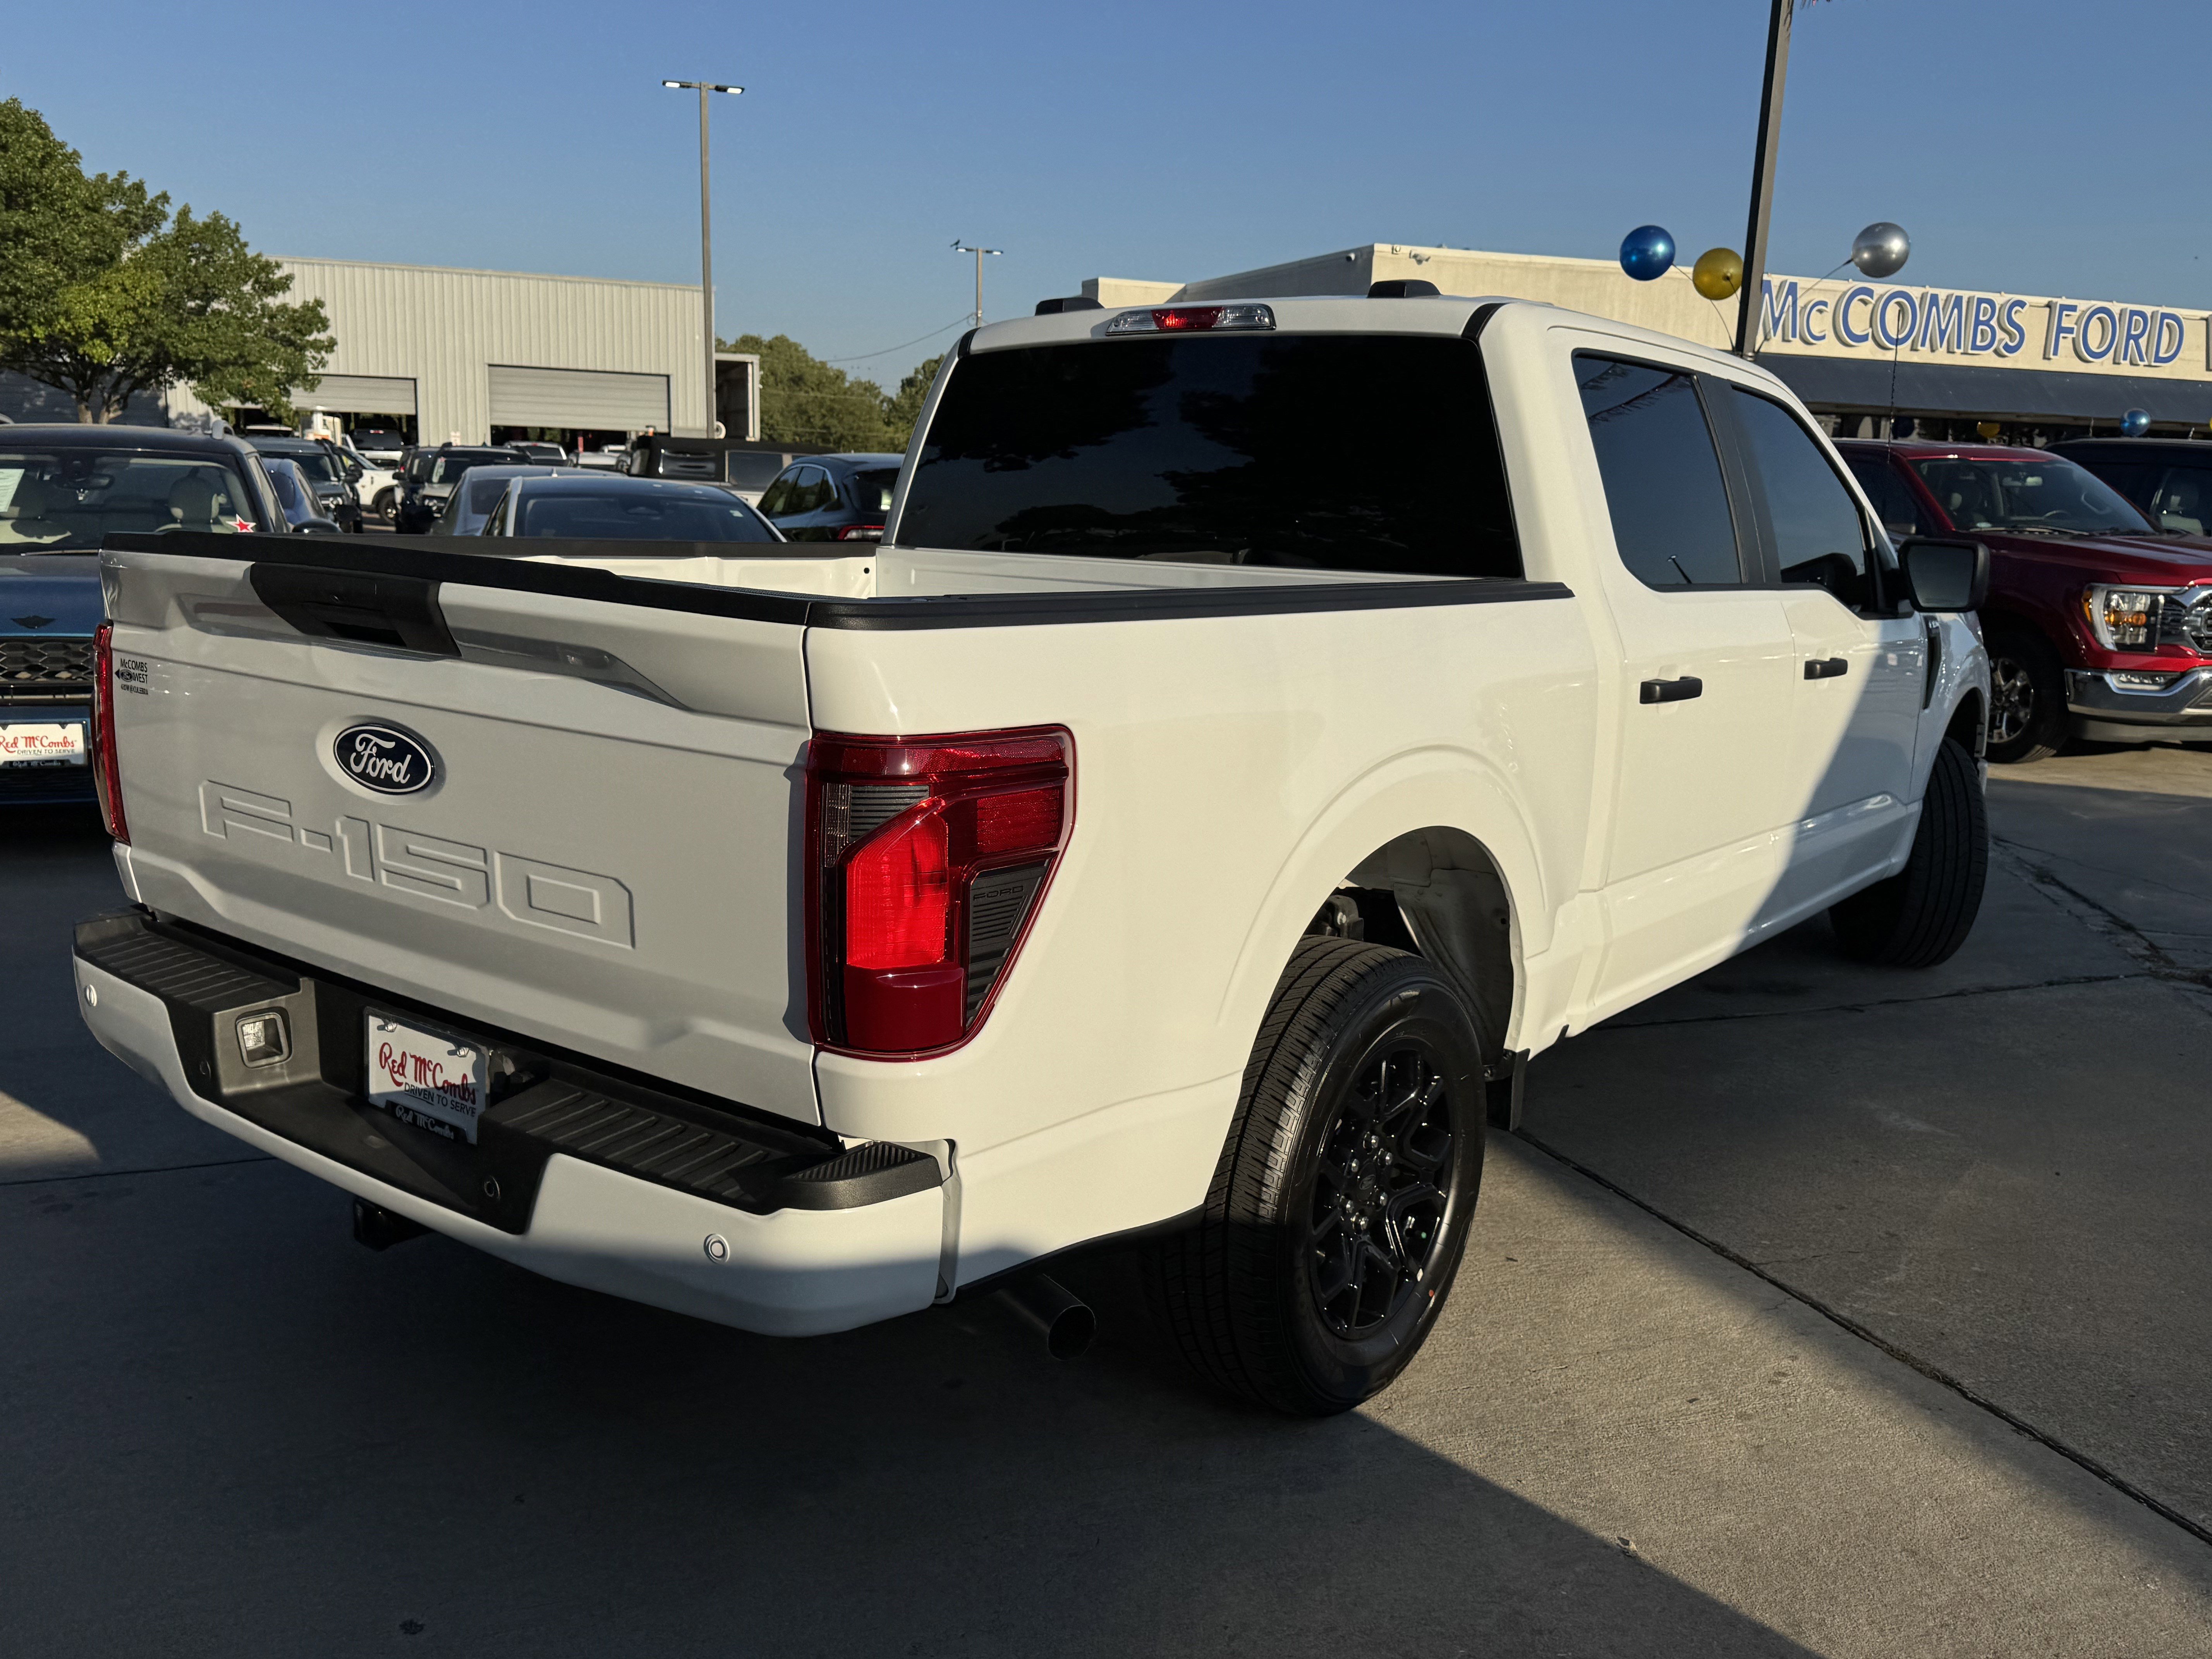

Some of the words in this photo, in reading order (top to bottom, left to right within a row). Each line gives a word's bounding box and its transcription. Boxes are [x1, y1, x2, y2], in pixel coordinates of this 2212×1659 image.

[1757, 277, 2029, 357] McCOMBS
[2045, 301, 2185, 367] FORD
[132, 672, 148, 684] WEST
[21, 735, 74, 749] McCombs
[350, 733, 411, 783] Ford
[199, 780, 635, 949] F-150
[973, 886, 1024, 901] FORD
[379, 1042, 406, 1087] Red
[409, 1052, 476, 1104] McCombs
[395, 1104, 413, 1123] Red
[404, 1082, 434, 1103] DRIVEN
[436, 1094, 448, 1107] TO
[450, 1100, 476, 1117] SERVE
